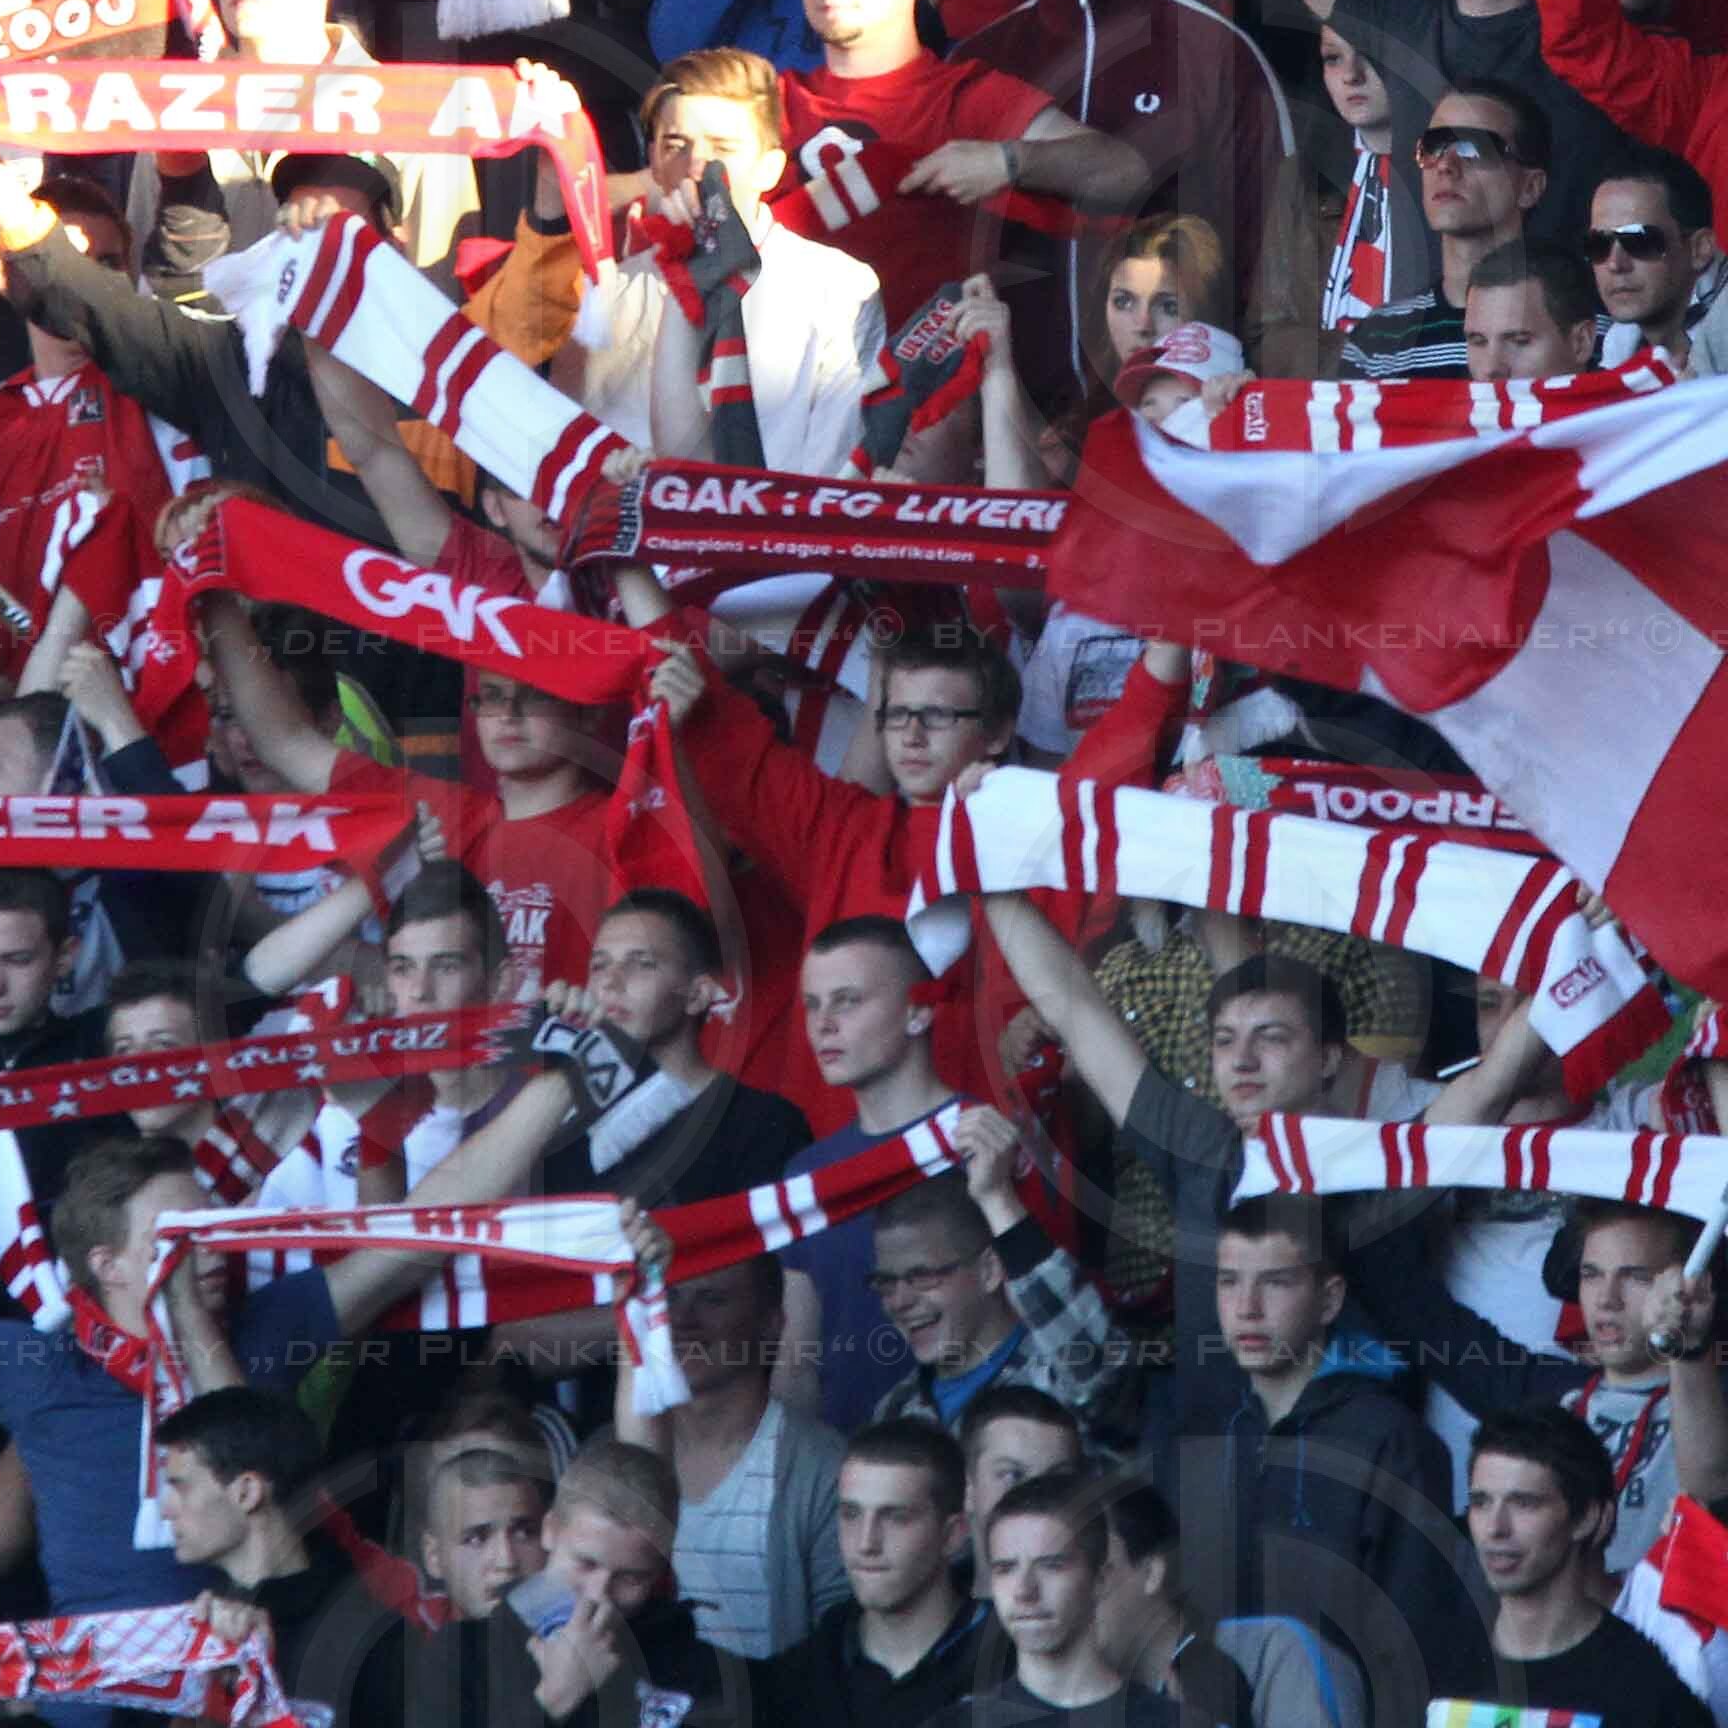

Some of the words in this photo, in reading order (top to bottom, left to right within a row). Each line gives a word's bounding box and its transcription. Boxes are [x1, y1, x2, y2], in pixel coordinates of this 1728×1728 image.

[648, 475, 774, 516] GAK
[809, 488, 885, 519] FC
[644, 535, 745, 555] Champions
[762, 538, 832, 560] League
[850, 543, 976, 564] Qualifikation
[341, 548, 540, 659] GAK
[185, 797, 354, 852] AK
